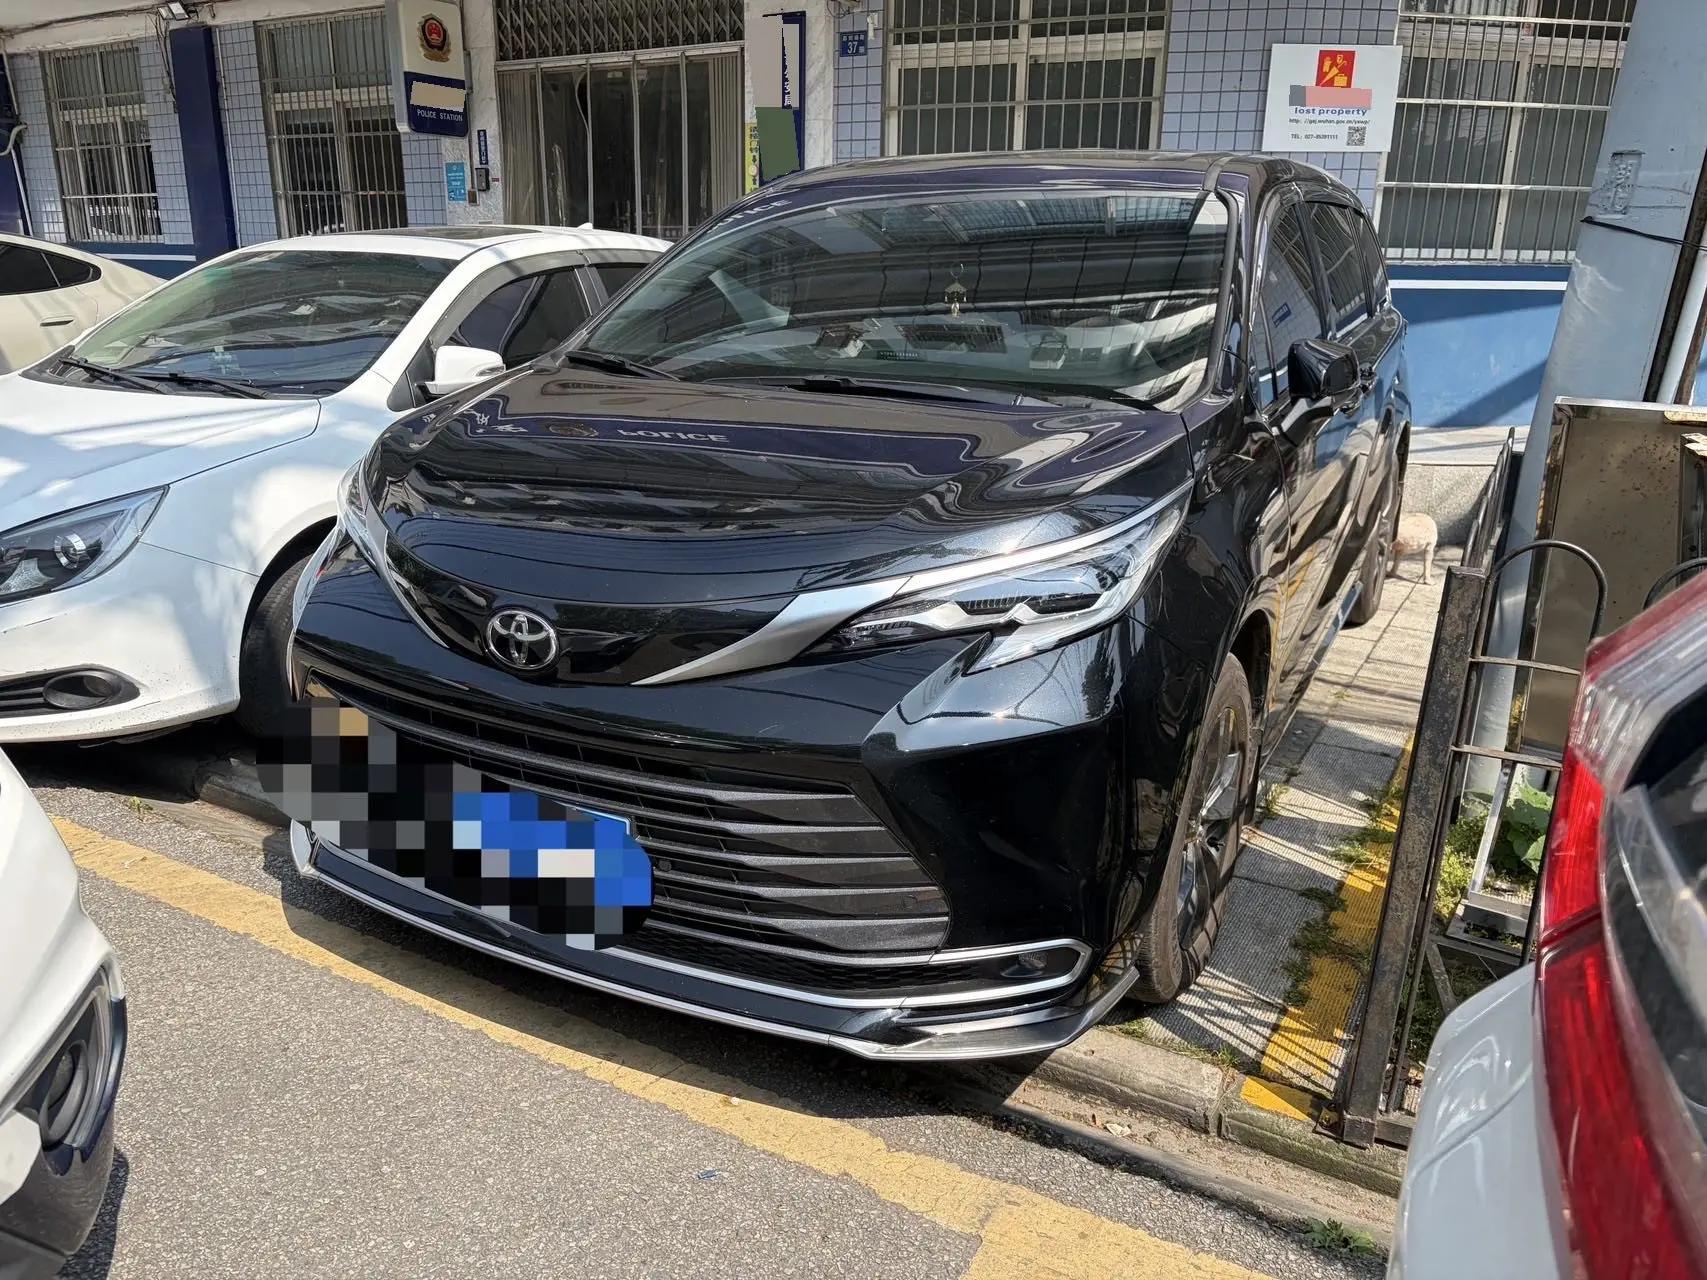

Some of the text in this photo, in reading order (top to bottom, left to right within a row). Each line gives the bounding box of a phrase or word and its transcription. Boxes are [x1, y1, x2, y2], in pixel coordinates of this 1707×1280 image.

[416, 108, 463, 122] POLICE STATION
[1294, 107, 1368, 116] lost property
